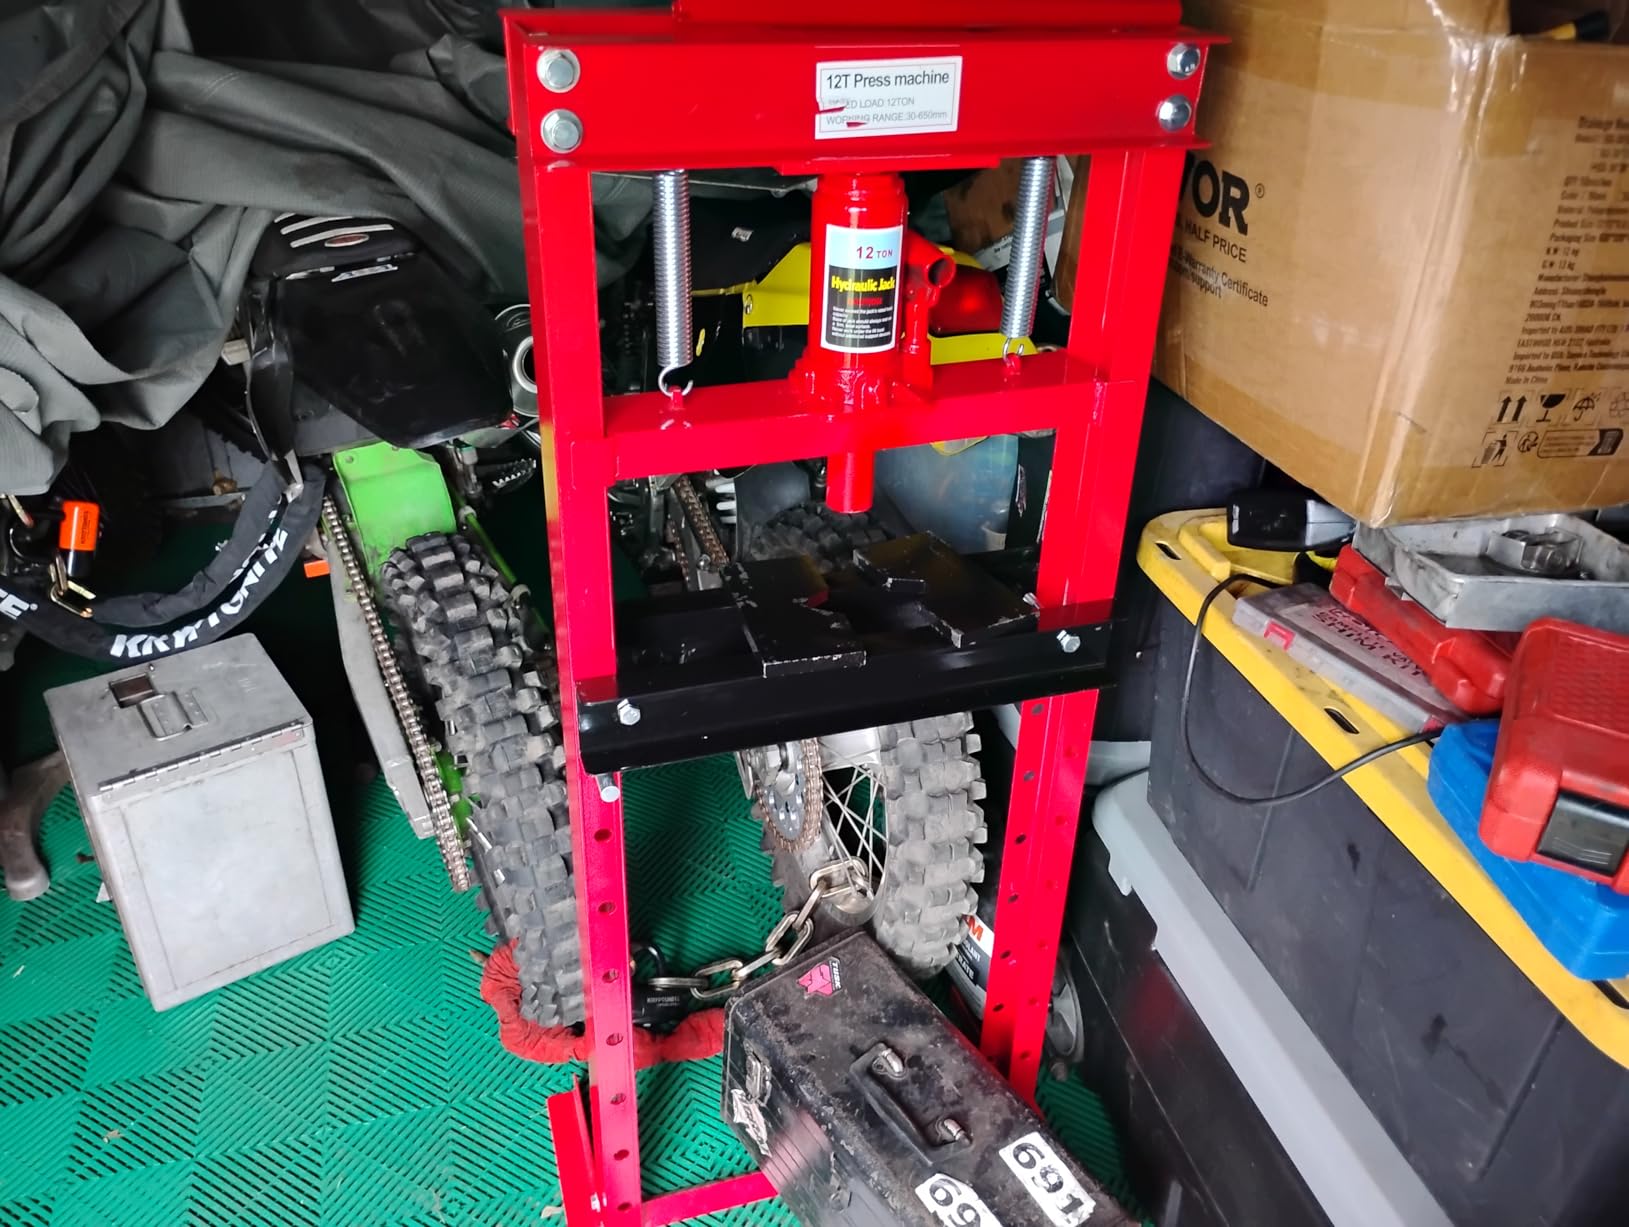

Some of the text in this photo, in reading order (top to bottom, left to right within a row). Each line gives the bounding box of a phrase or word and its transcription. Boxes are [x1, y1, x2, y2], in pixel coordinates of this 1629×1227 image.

[827, 69, 950, 89] 12T Press machine
[860, 98, 884, 109] LOAD
[887, 96, 915, 107] 12TON
[856, 246, 893, 259] 12 TON
[1212, 234, 1248, 263] PRICE
[831, 275, 896, 292] Hydraulic Jack
[1221, 271, 1269, 307] Certificate
[1011, 1143, 1087, 1216] 691
